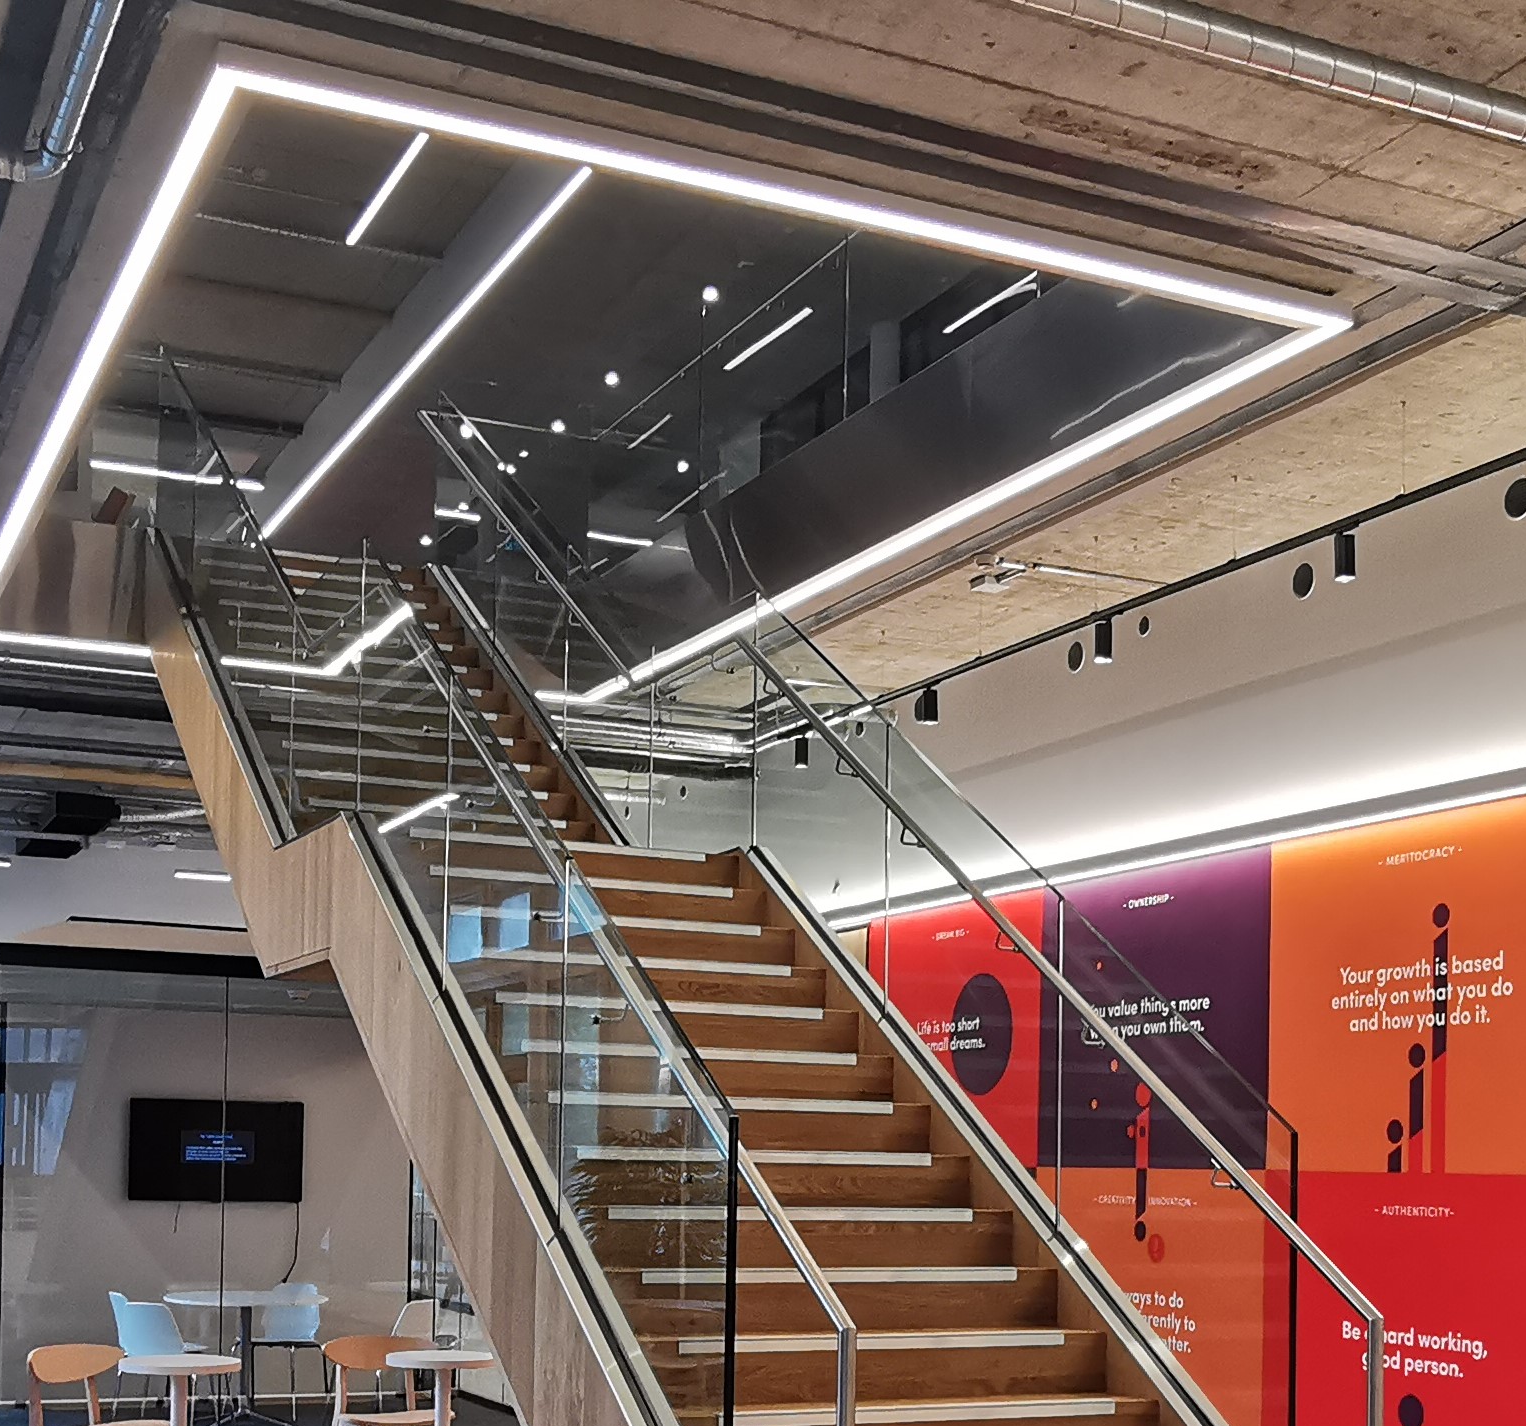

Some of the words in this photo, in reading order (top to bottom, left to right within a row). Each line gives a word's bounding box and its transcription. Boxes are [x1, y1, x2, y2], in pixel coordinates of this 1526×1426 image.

[1385, 845, 1456, 866] MERITOCRACY
[1128, 893, 1170, 910] OWNERSHIP
[1340, 966, 1374, 985] Your
[1376, 958, 1431, 987] growth
[1435, 957, 1448, 976] is
[1451, 950, 1504, 974] based
[1331, 988, 1387, 1011] entirely
[1390, 992, 1409, 1004] on
[1413, 982, 1453, 1003] what
[1457, 982, 1487, 1006] you
[1491, 976, 1514, 997] do
[1107, 999, 1138, 1017] value
[1140, 996, 1177, 1016] things
[1179, 997, 1210, 1012] more
[917, 1020, 932, 1036] Life
[933, 1020, 940, 1034] is
[941, 1020, 956, 1033] too
[957, 1016, 980, 1032] short
[1349, 1012, 1379, 1032] and
[1382, 1011, 1414, 1030] how
[1417, 1012, 1446, 1033] you
[1449, 1005, 1472, 1025] do
[1475, 1004, 1491, 1024] it.
[1121, 1023, 1141, 1041] you
[1143, 1020, 1167, 1035] own
[950, 1035, 986, 1051] dreams.
[1381, 1205, 1450, 1218] AUTHENTICITY
[1154, 1291, 1166, 1307] to
[1168, 1290, 1184, 1309] do
[1184, 1315, 1196, 1332] to
[1162, 1335, 1192, 1354] tter.
[1342, 1320, 1361, 1341] Be
[1418, 1331, 1488, 1360] working,
[1404, 1357, 1464, 1378] person.
